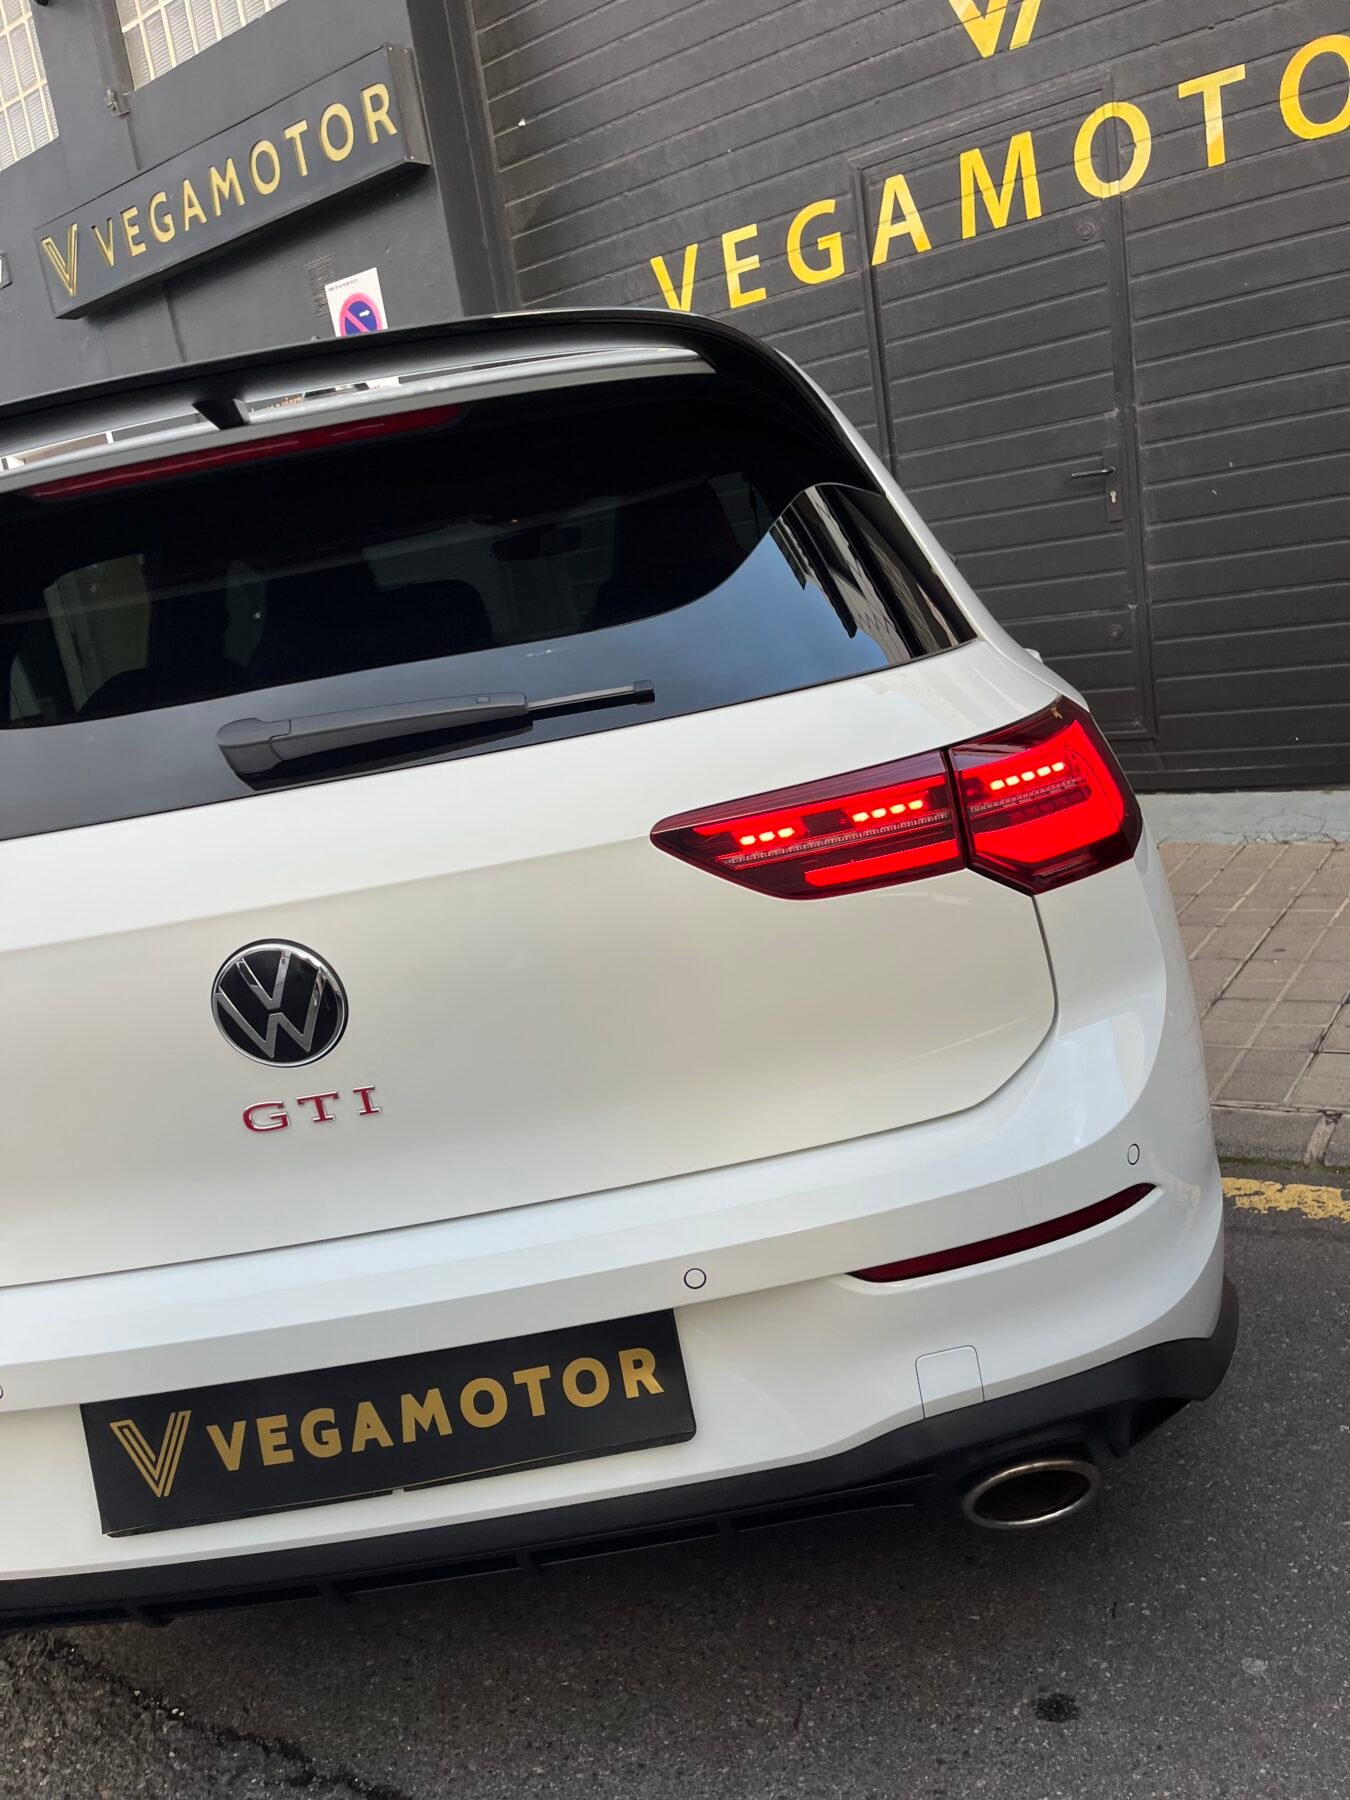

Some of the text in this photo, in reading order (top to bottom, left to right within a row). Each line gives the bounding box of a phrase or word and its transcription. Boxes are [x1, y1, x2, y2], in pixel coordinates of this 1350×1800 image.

[91, 82, 398, 268] VEGAMOTOR
[242, 1084, 382, 1132] GTI
[206, 1346, 665, 1472] VEGAMOTOR
